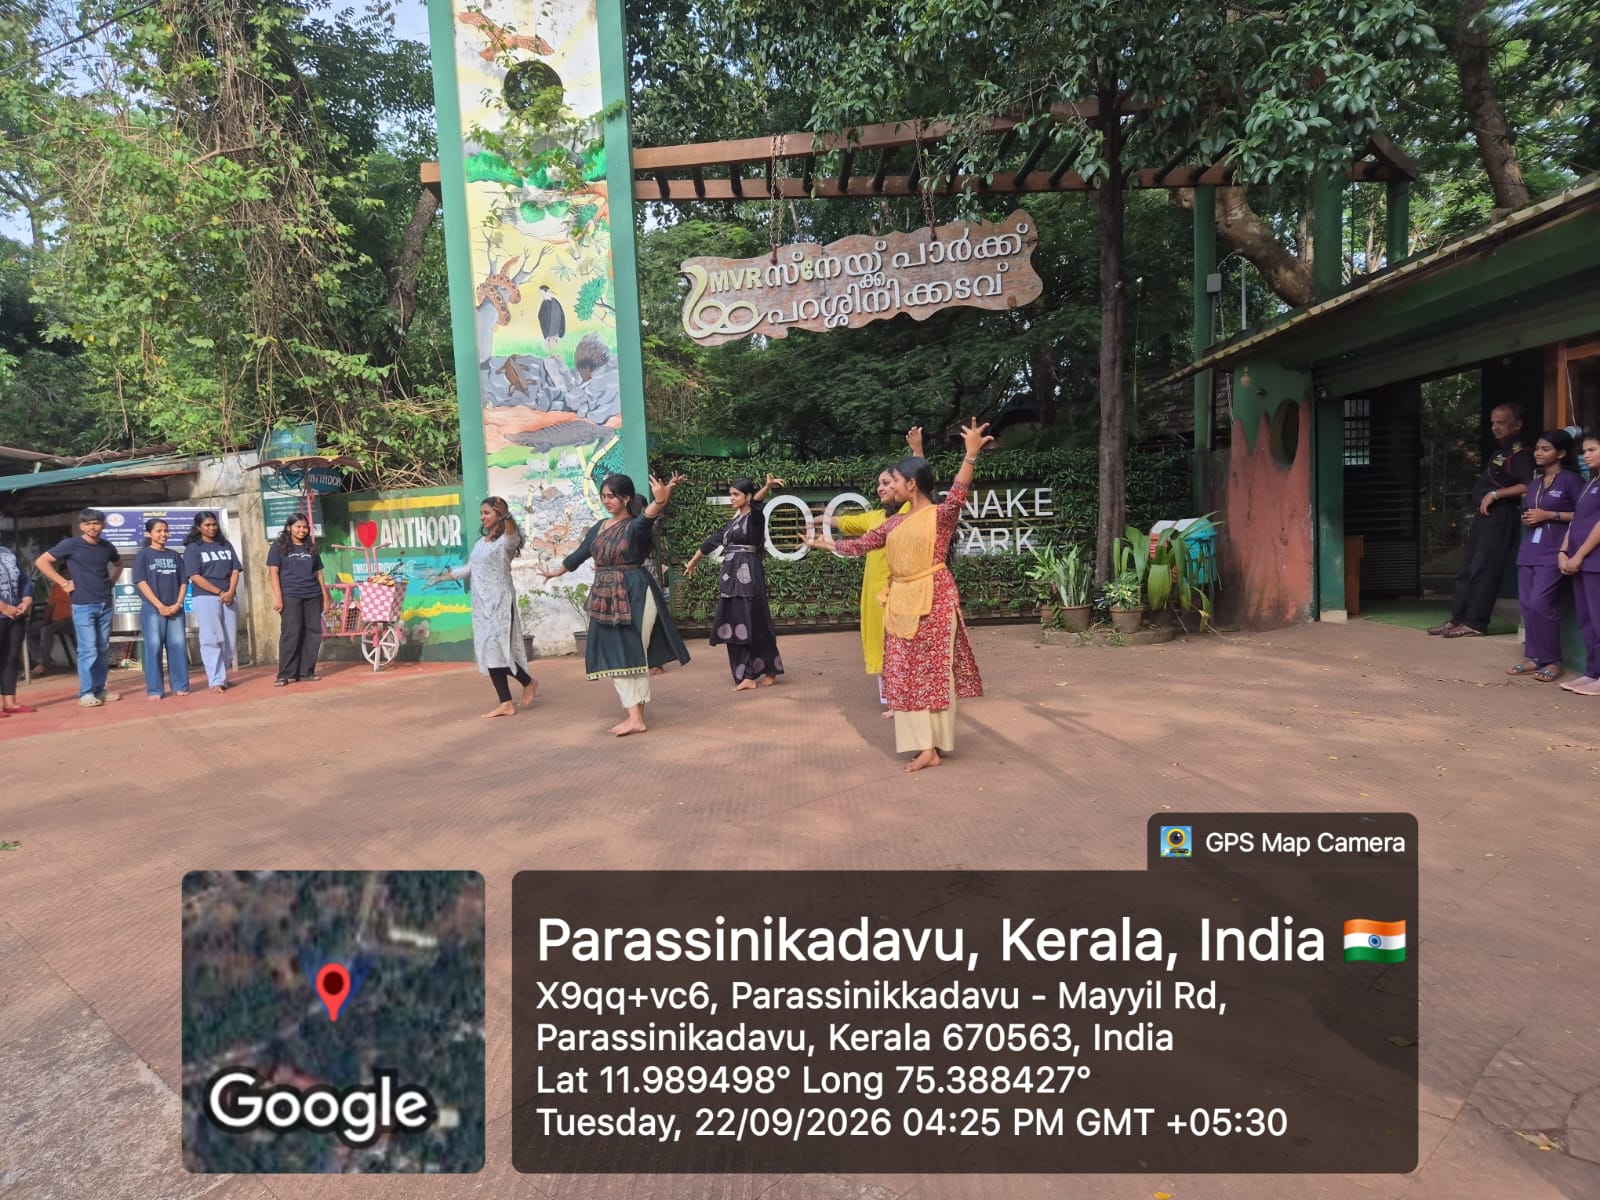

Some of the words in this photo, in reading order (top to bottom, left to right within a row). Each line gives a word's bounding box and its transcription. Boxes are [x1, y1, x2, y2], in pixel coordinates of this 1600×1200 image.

[709, 267, 763, 293] MVR
[892, 223, 1029, 269] പാർക്ക്
[938, 488, 1054, 518] NAKE
[380, 514, 463, 549] ANTHOOR
[957, 527, 1034, 557] ARK
